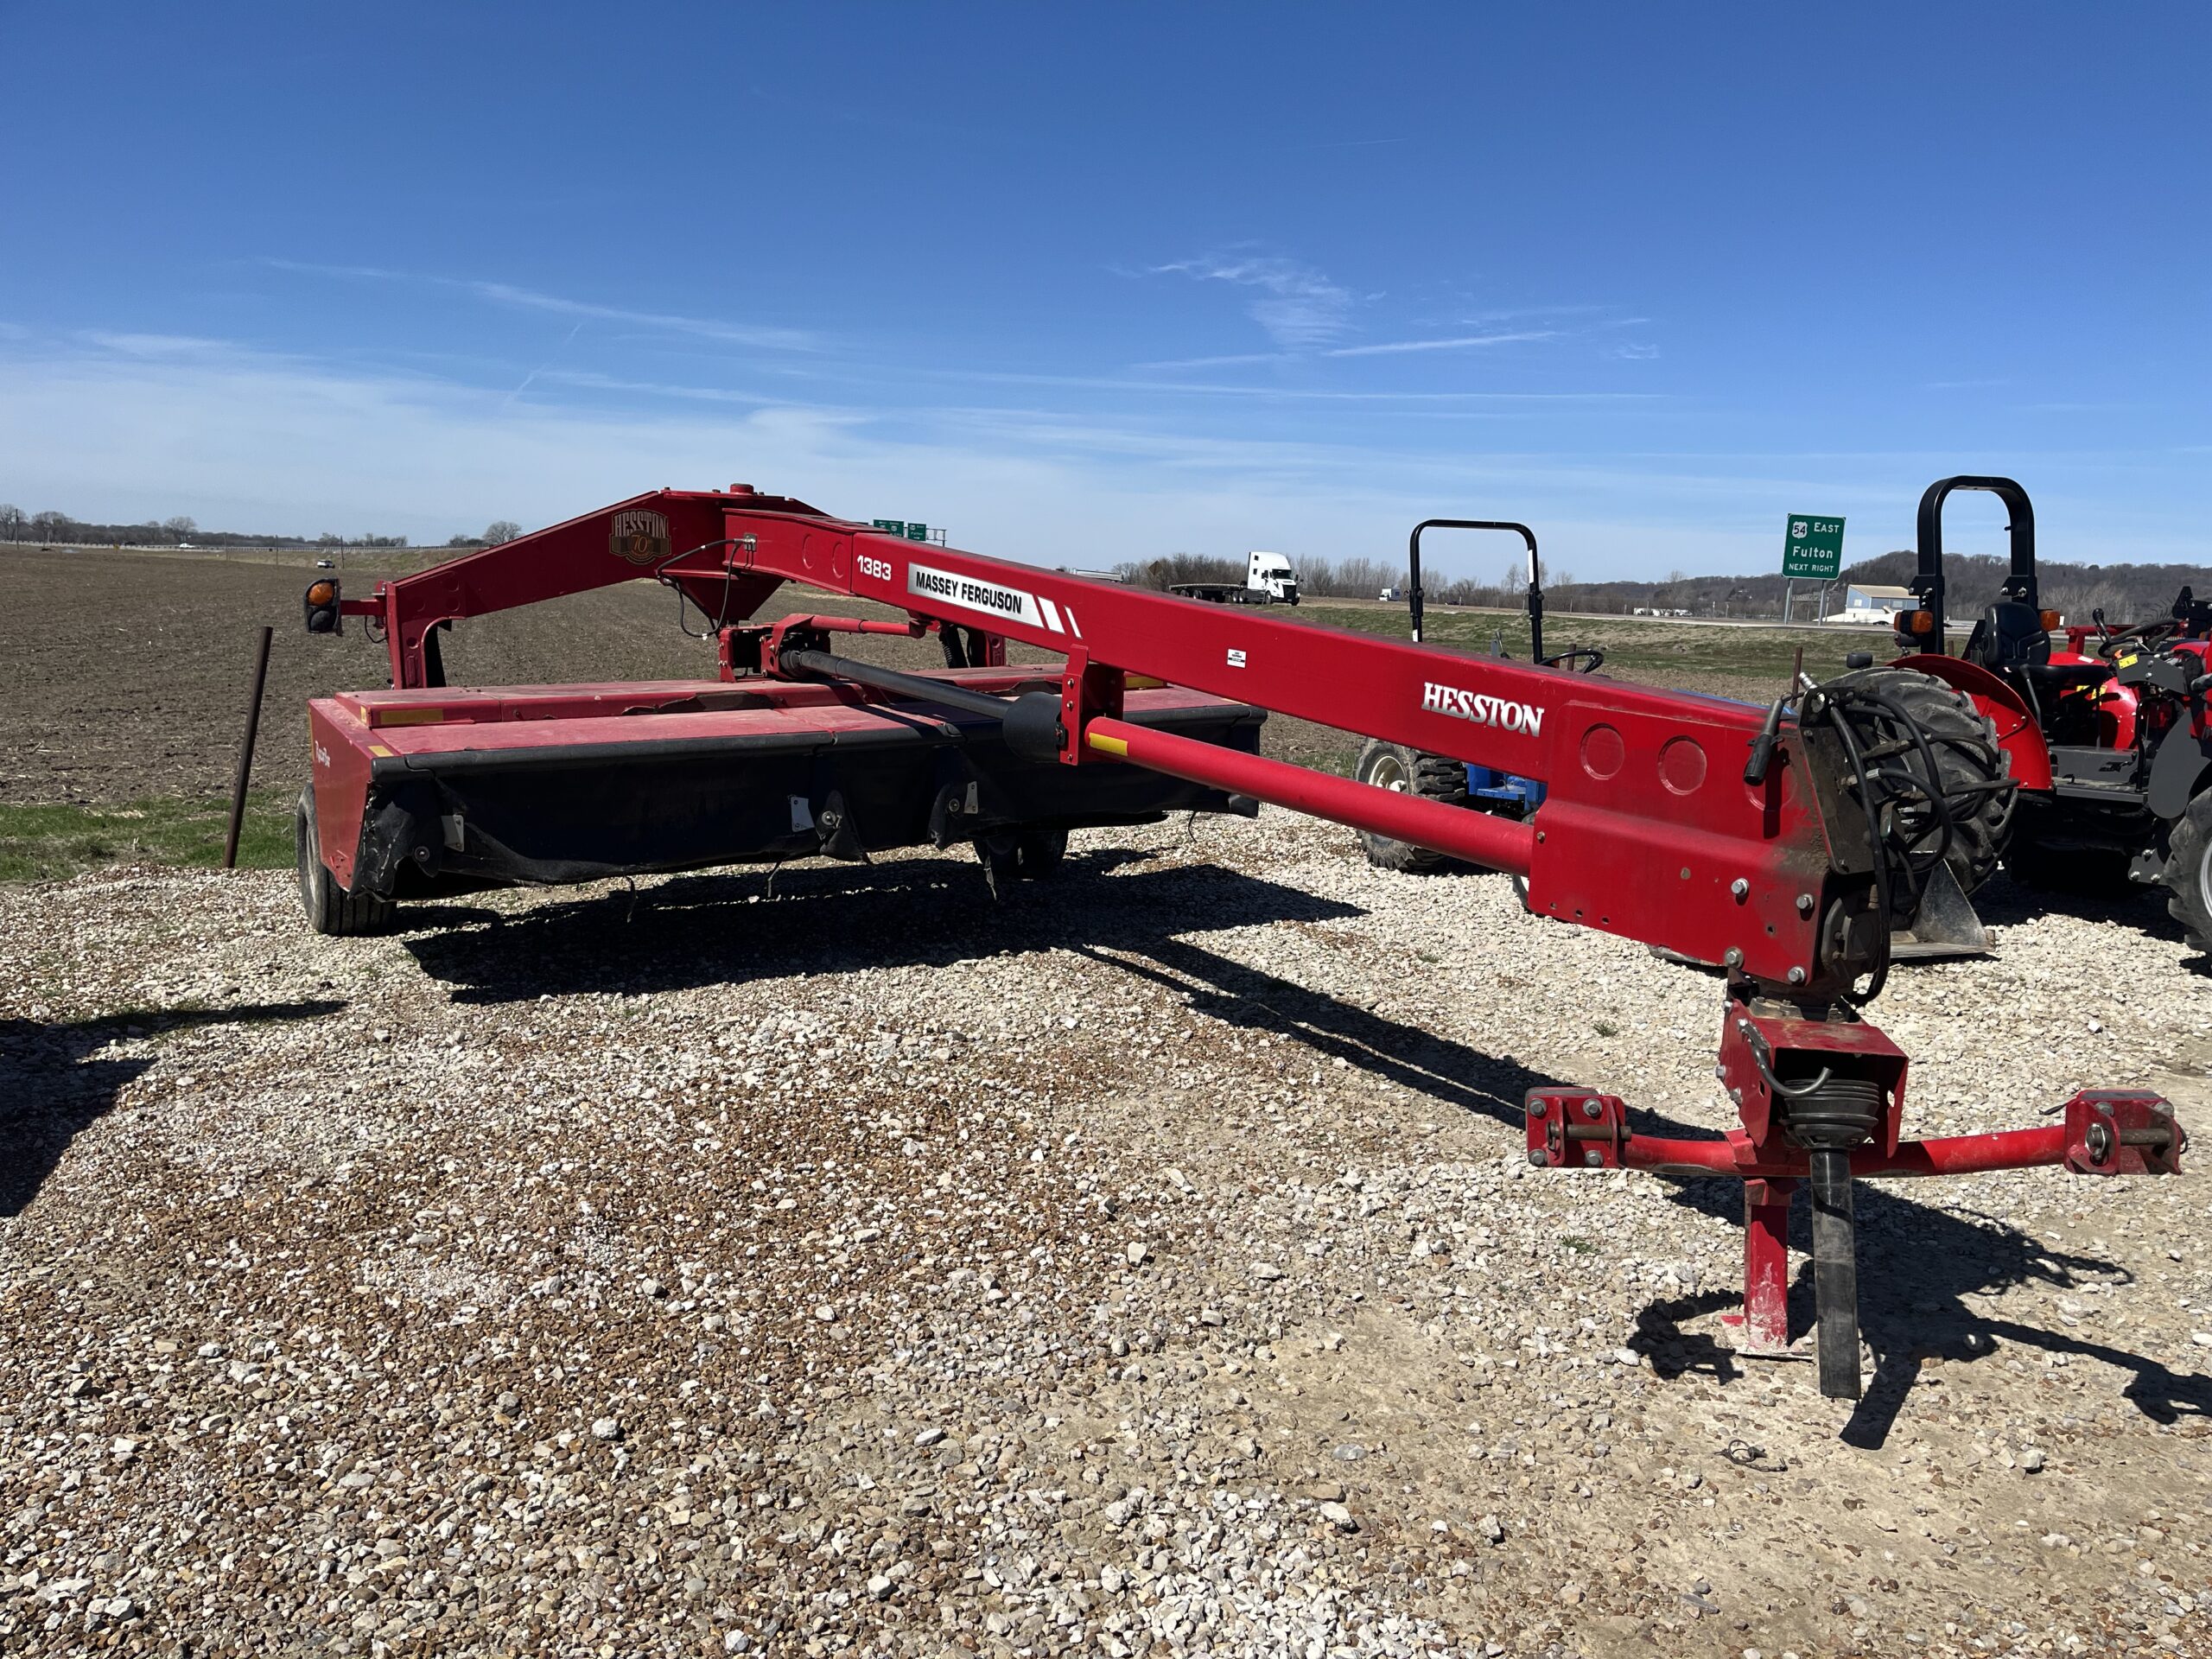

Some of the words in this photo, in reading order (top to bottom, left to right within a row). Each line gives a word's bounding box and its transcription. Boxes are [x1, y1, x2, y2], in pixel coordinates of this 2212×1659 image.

[614, 511, 666, 539] HESSTON
[1793, 524, 1806, 536] 54
[1814, 522, 1840, 533] EAST
[631, 534, 648, 553] 70
[1792, 545, 1834, 559] Fulton
[856, 555, 892, 582] 1383
[1789, 563, 1808, 571] NEXT
[1811, 564, 1834, 573] RIGHT
[916, 571, 959, 598] MASSEY
[961, 582, 1022, 614] FERGUSON
[1421, 681, 1545, 738] HESSTON
